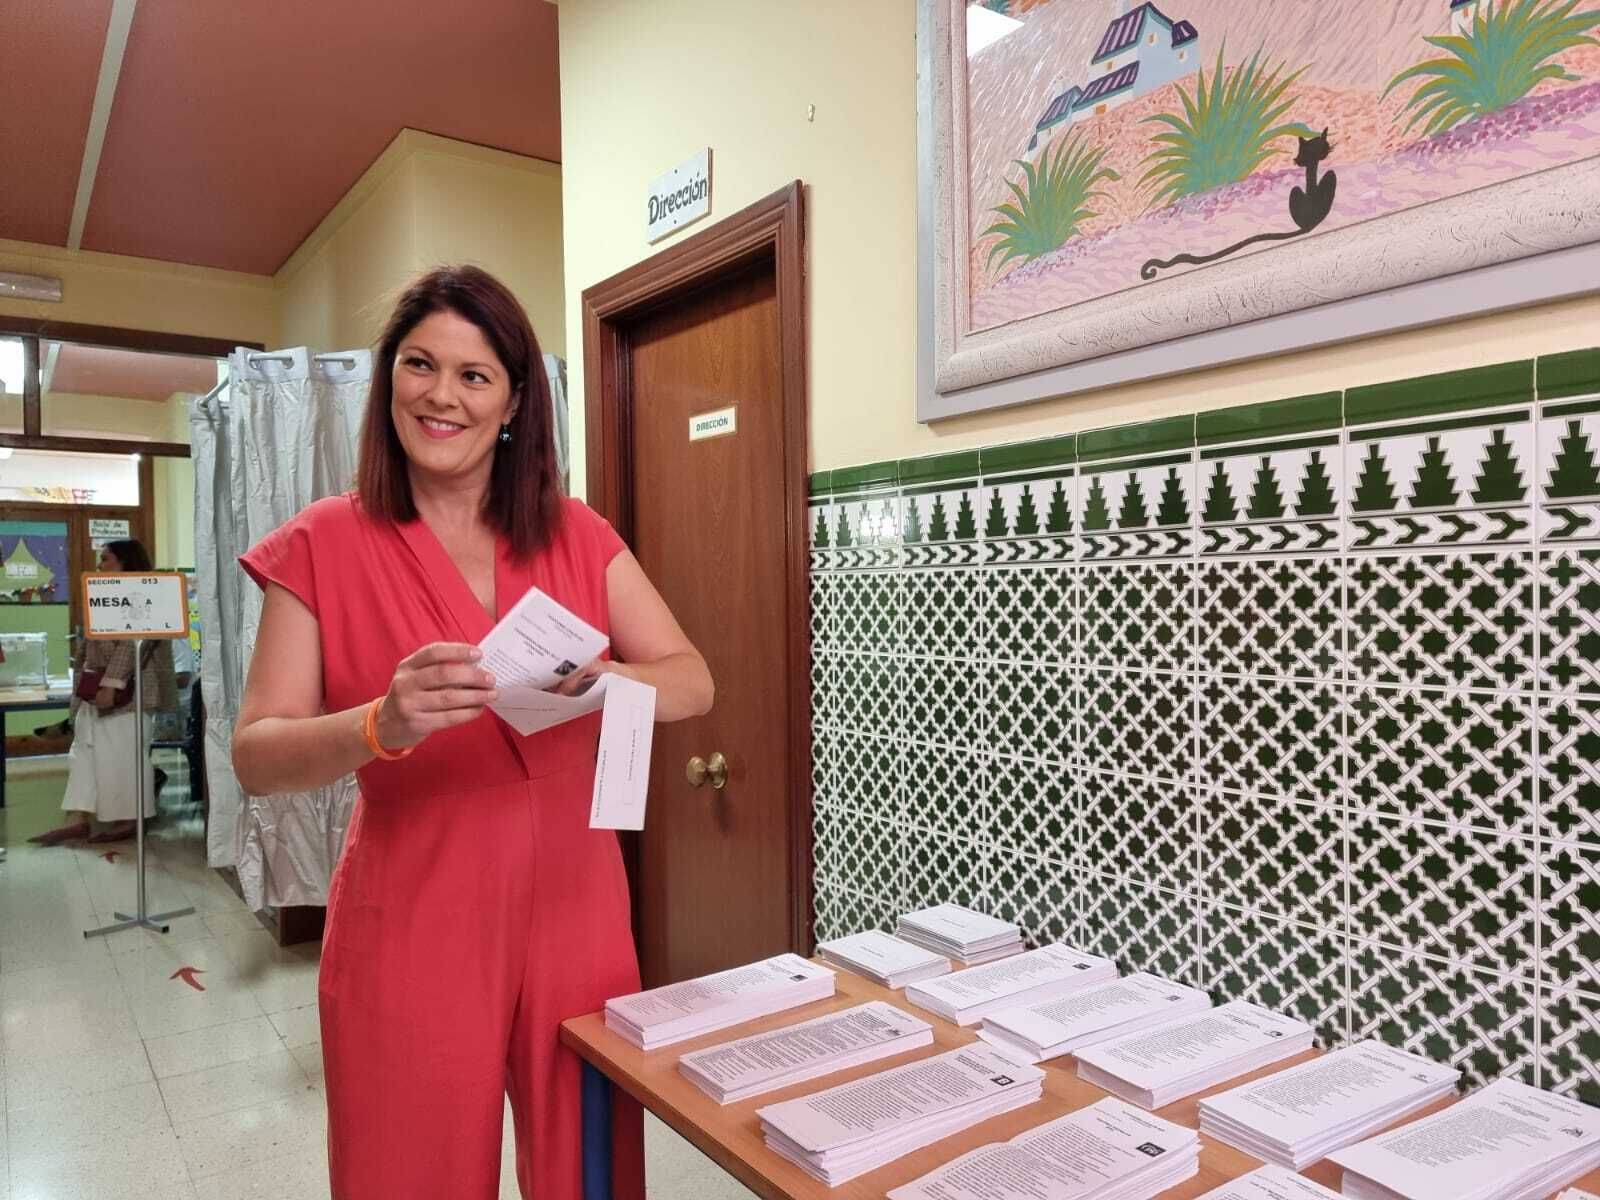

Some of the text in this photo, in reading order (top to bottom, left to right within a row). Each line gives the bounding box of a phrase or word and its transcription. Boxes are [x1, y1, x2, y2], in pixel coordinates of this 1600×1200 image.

[648, 171, 707, 225] Dirección
[696, 416, 728, 431] DIRECCIÓN
[89, 597, 131, 607] MESA
